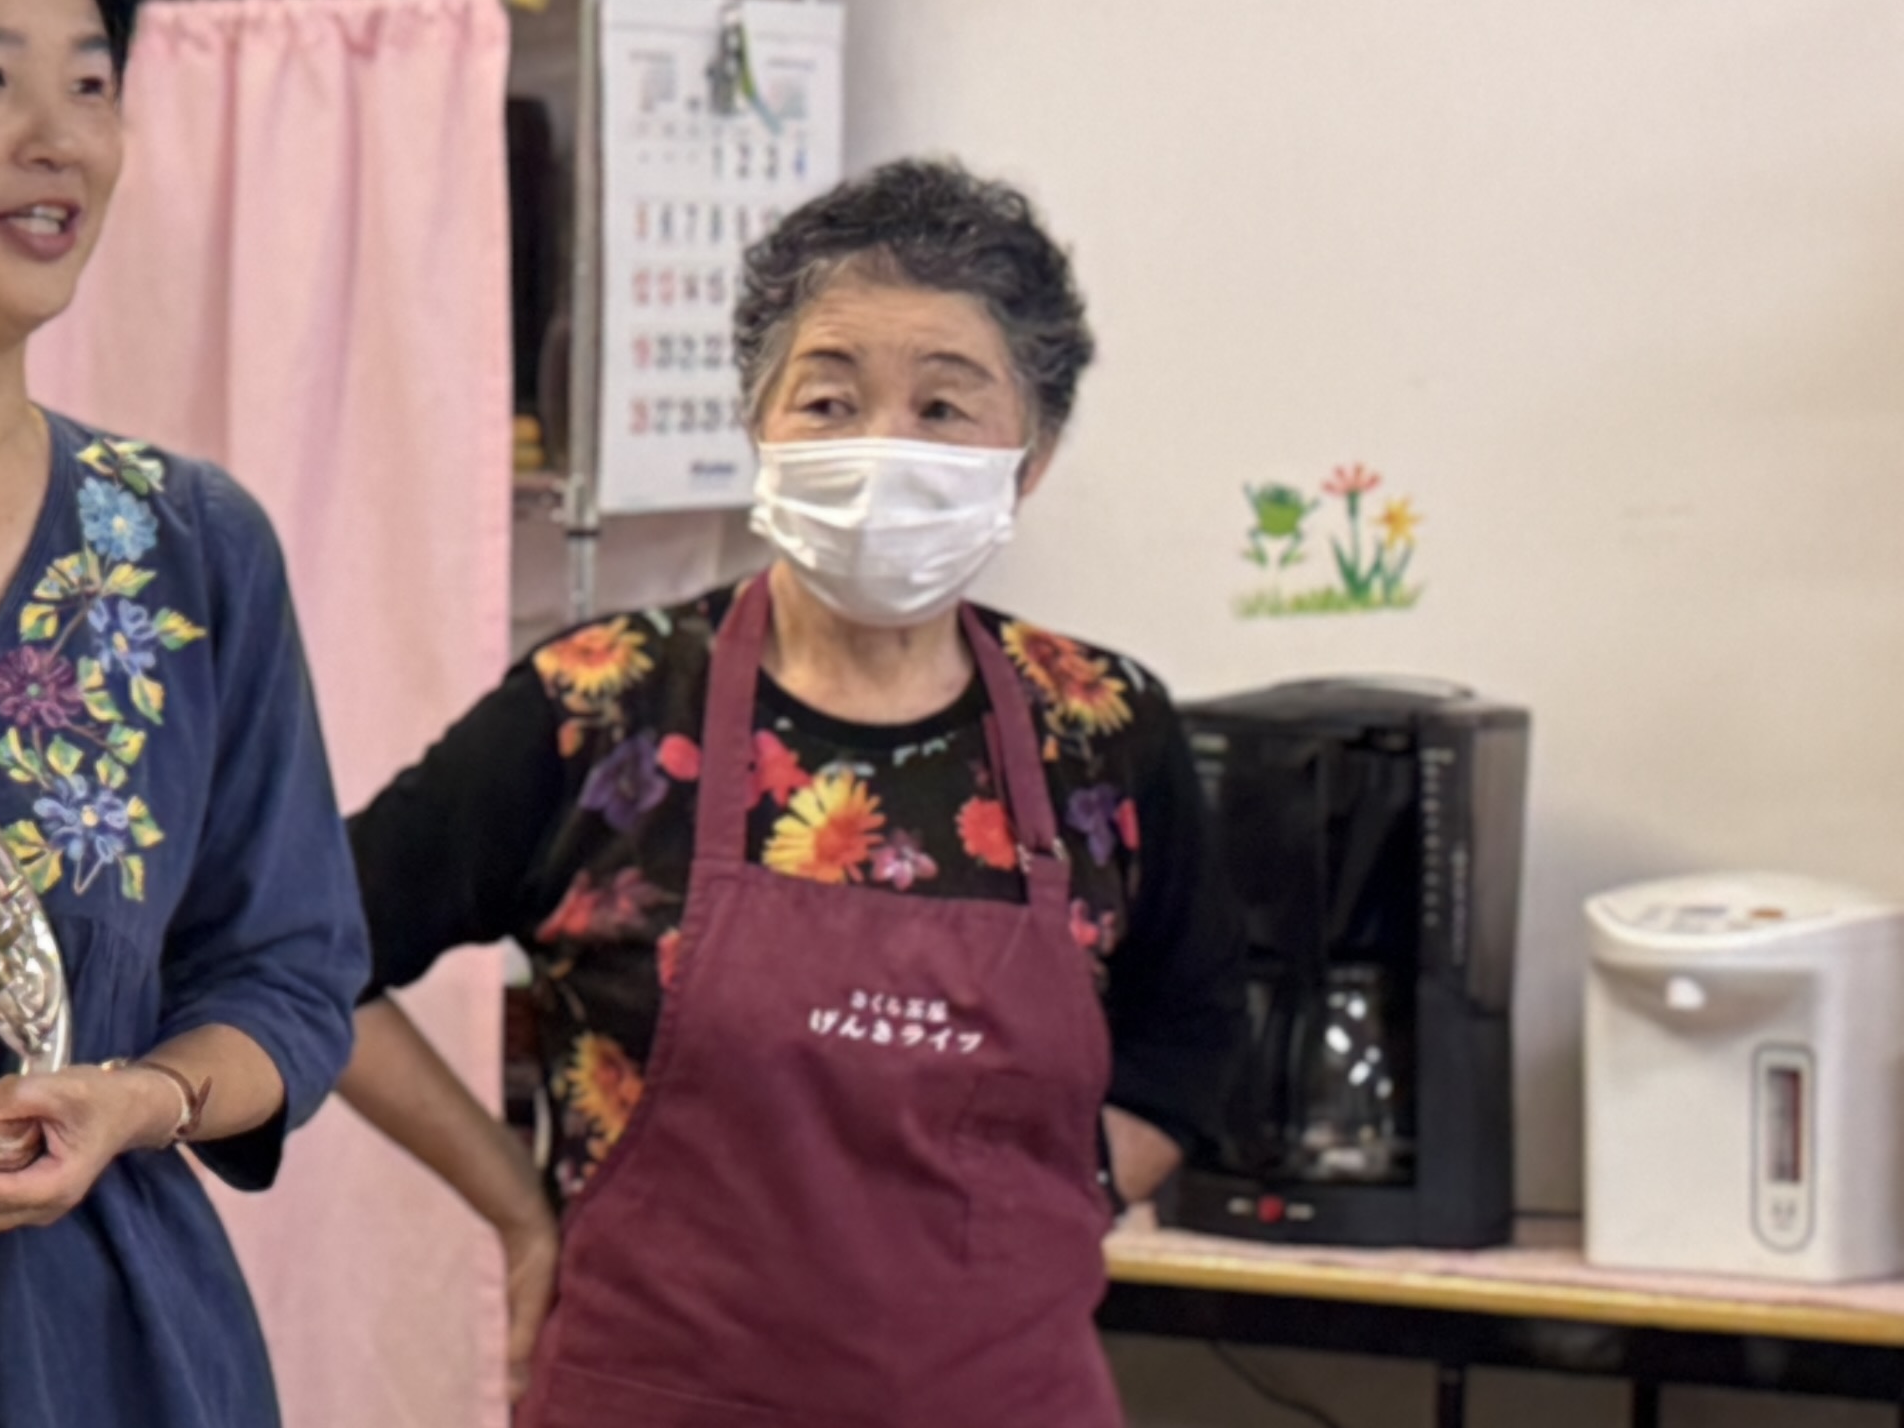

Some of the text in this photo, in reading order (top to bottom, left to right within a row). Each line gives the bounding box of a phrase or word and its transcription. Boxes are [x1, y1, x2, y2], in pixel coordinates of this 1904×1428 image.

[808, 1008, 985, 1054] げんきライフ
